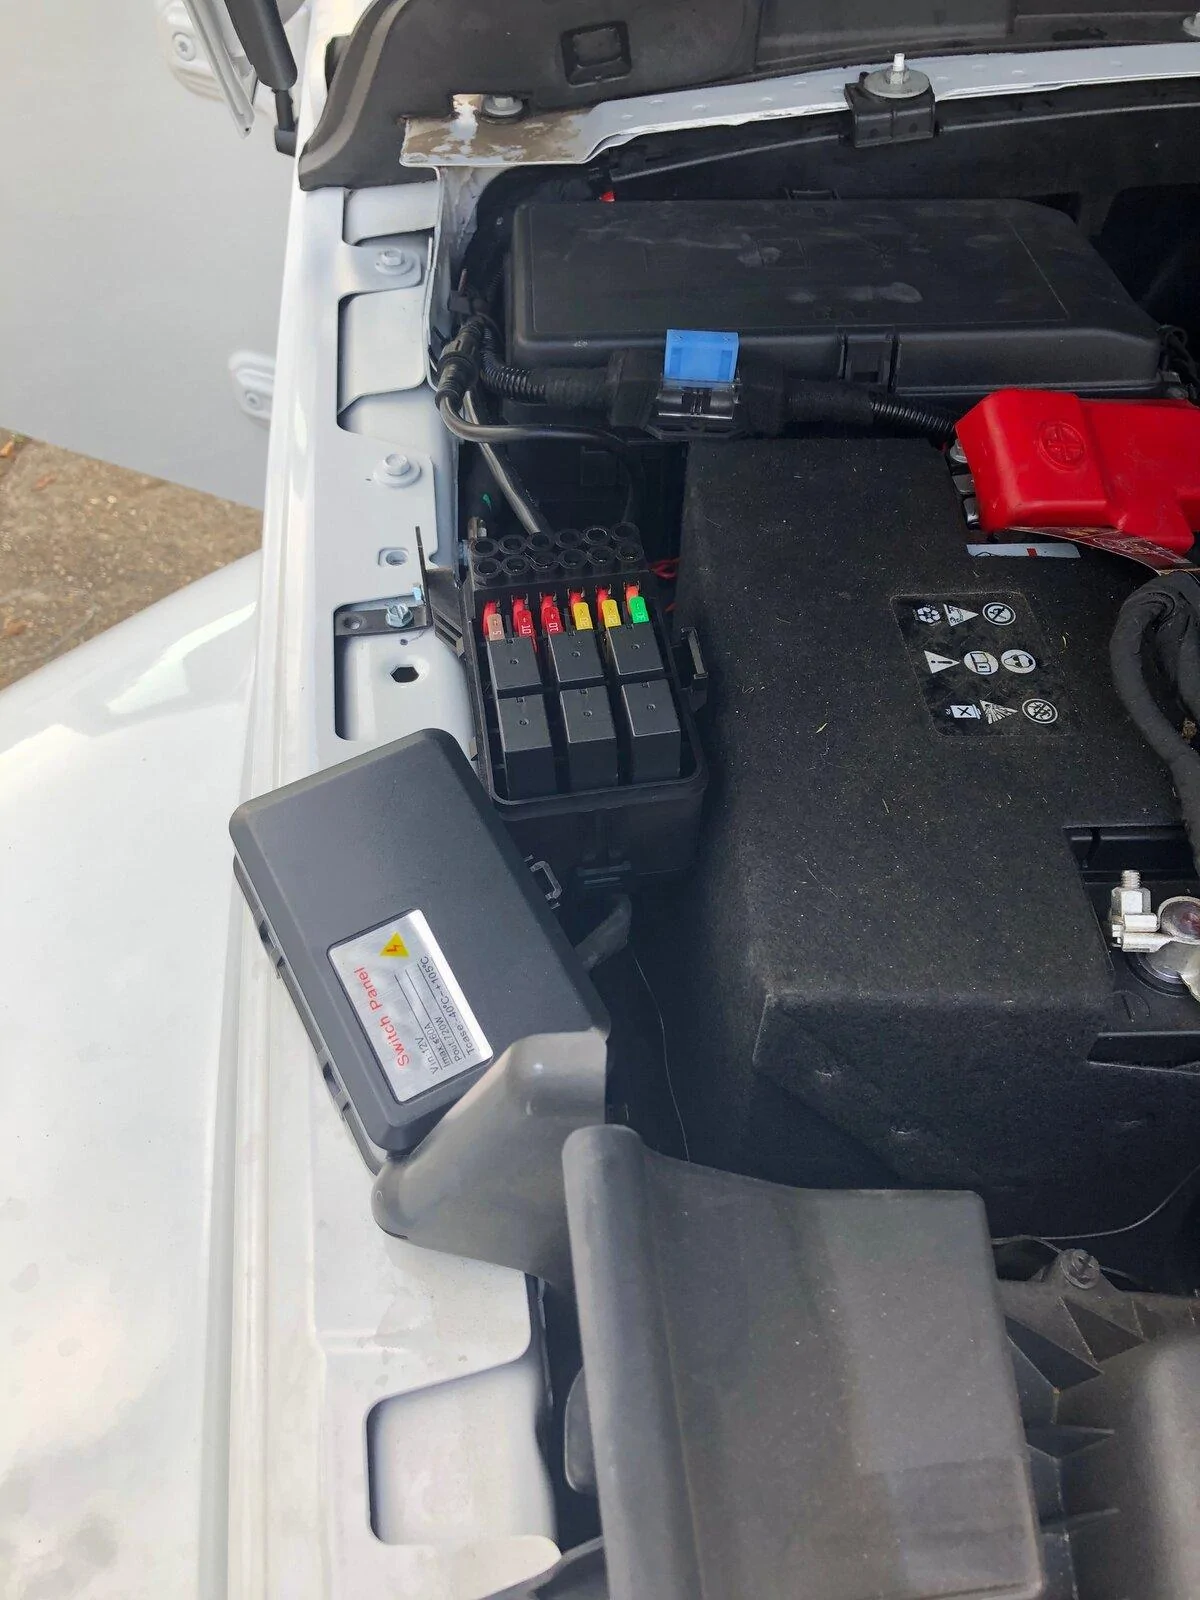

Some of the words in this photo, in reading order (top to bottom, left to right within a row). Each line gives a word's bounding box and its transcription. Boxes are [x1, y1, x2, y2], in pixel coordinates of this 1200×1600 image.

[521, 625, 532, 634] 10
[548, 622, 559, 632] 10
[353, 966, 383, 1011] Panel
[379, 1015, 410, 1067] Switch
[415, 1037, 437, 1074] Vin:12V
